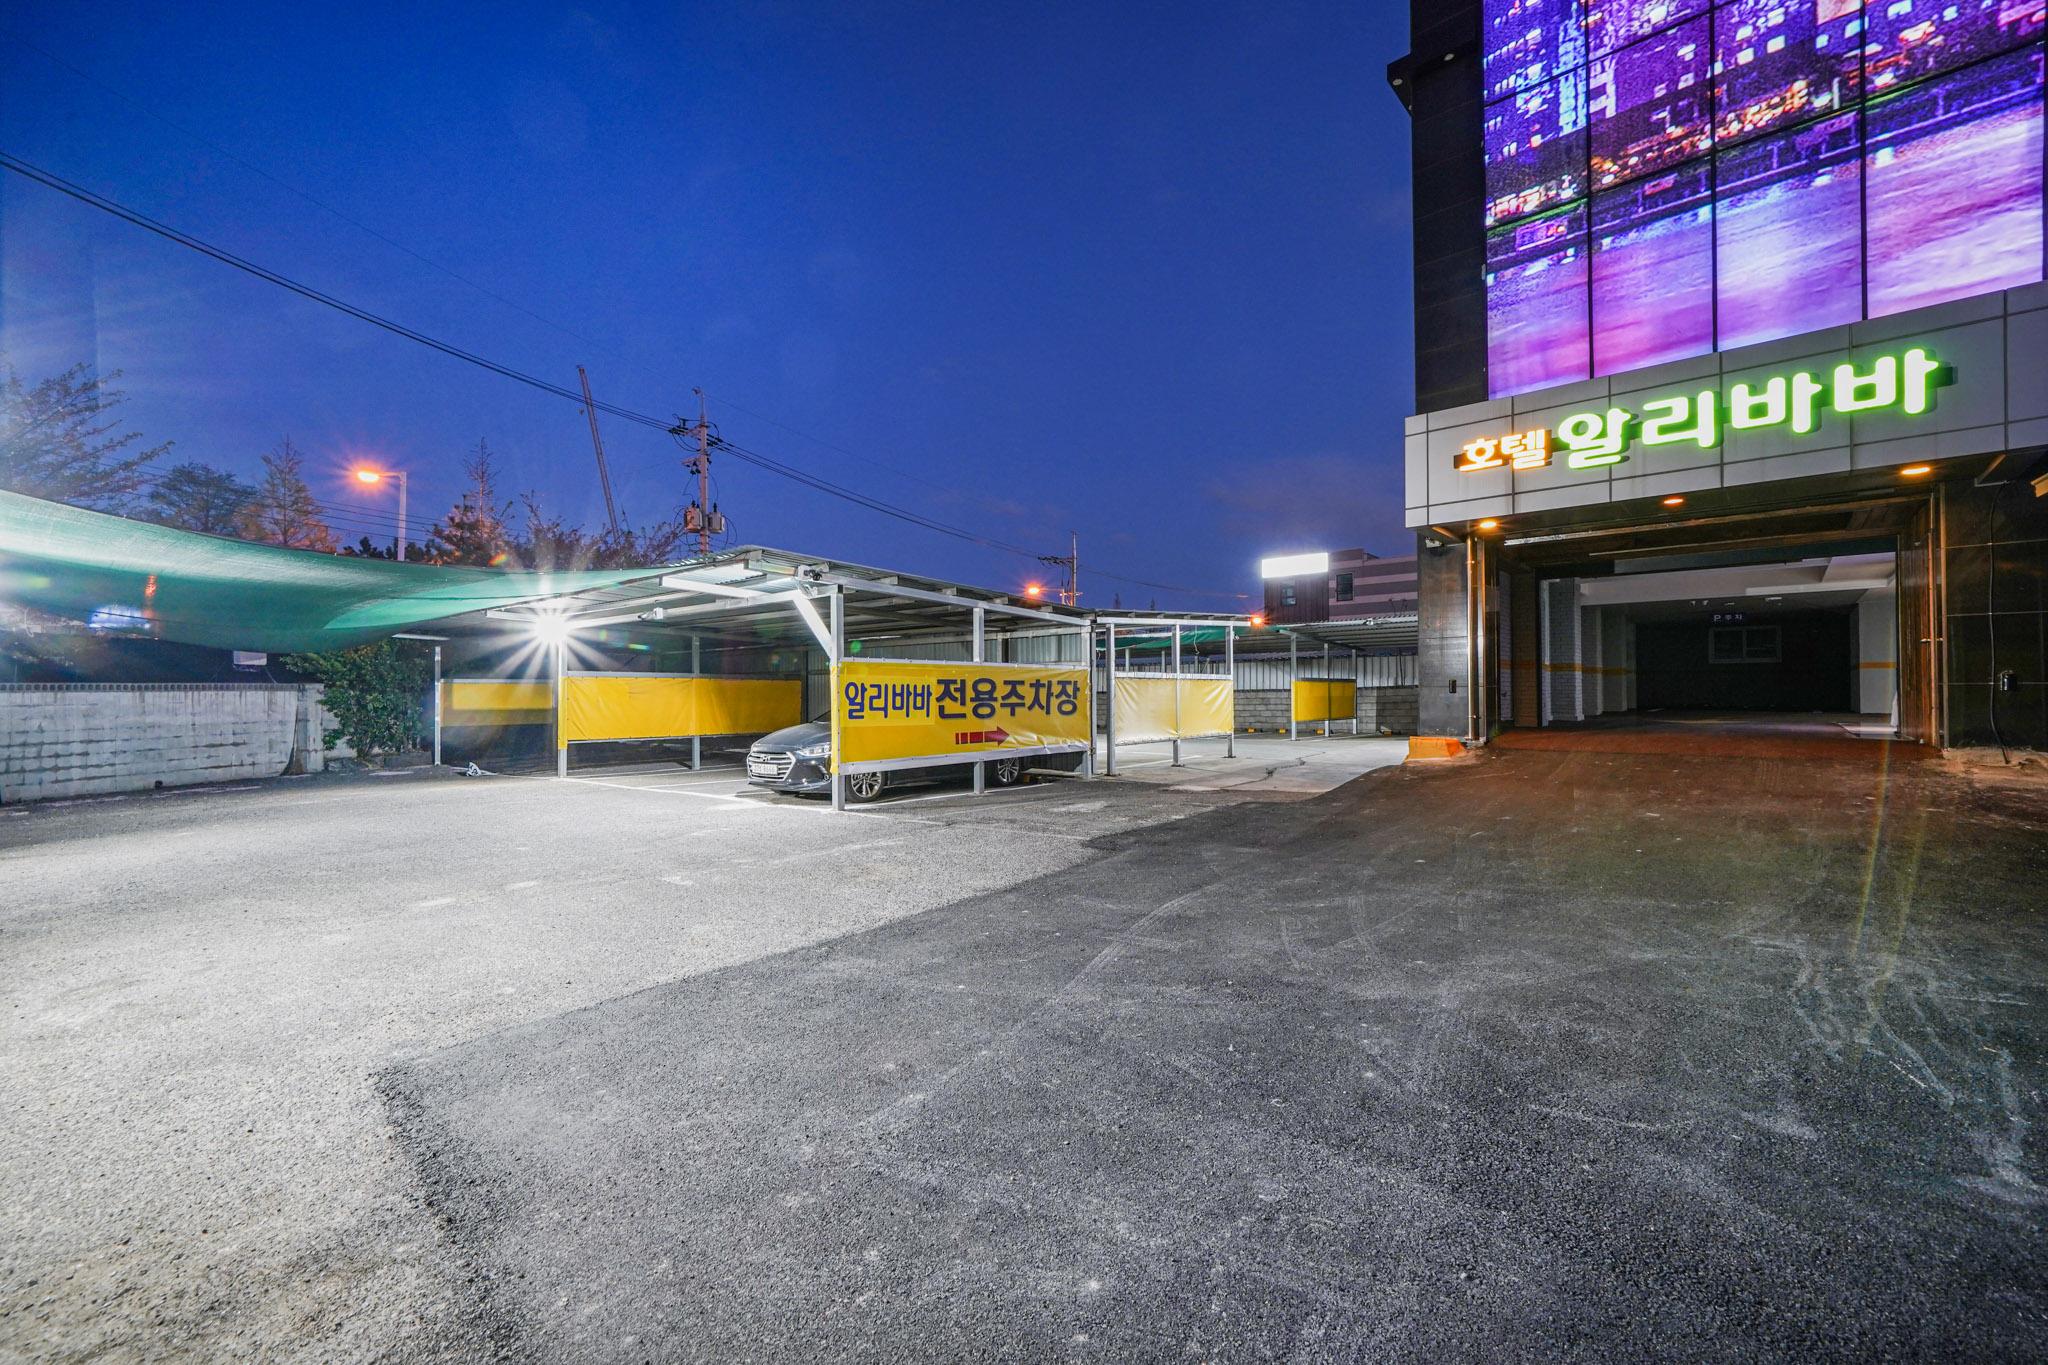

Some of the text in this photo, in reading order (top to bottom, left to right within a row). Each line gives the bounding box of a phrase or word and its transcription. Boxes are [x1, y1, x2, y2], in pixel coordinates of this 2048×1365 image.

[1459, 348, 1939, 471] 호텔 알리바바
[844, 677, 1081, 720] 알리바바 전용주차장
